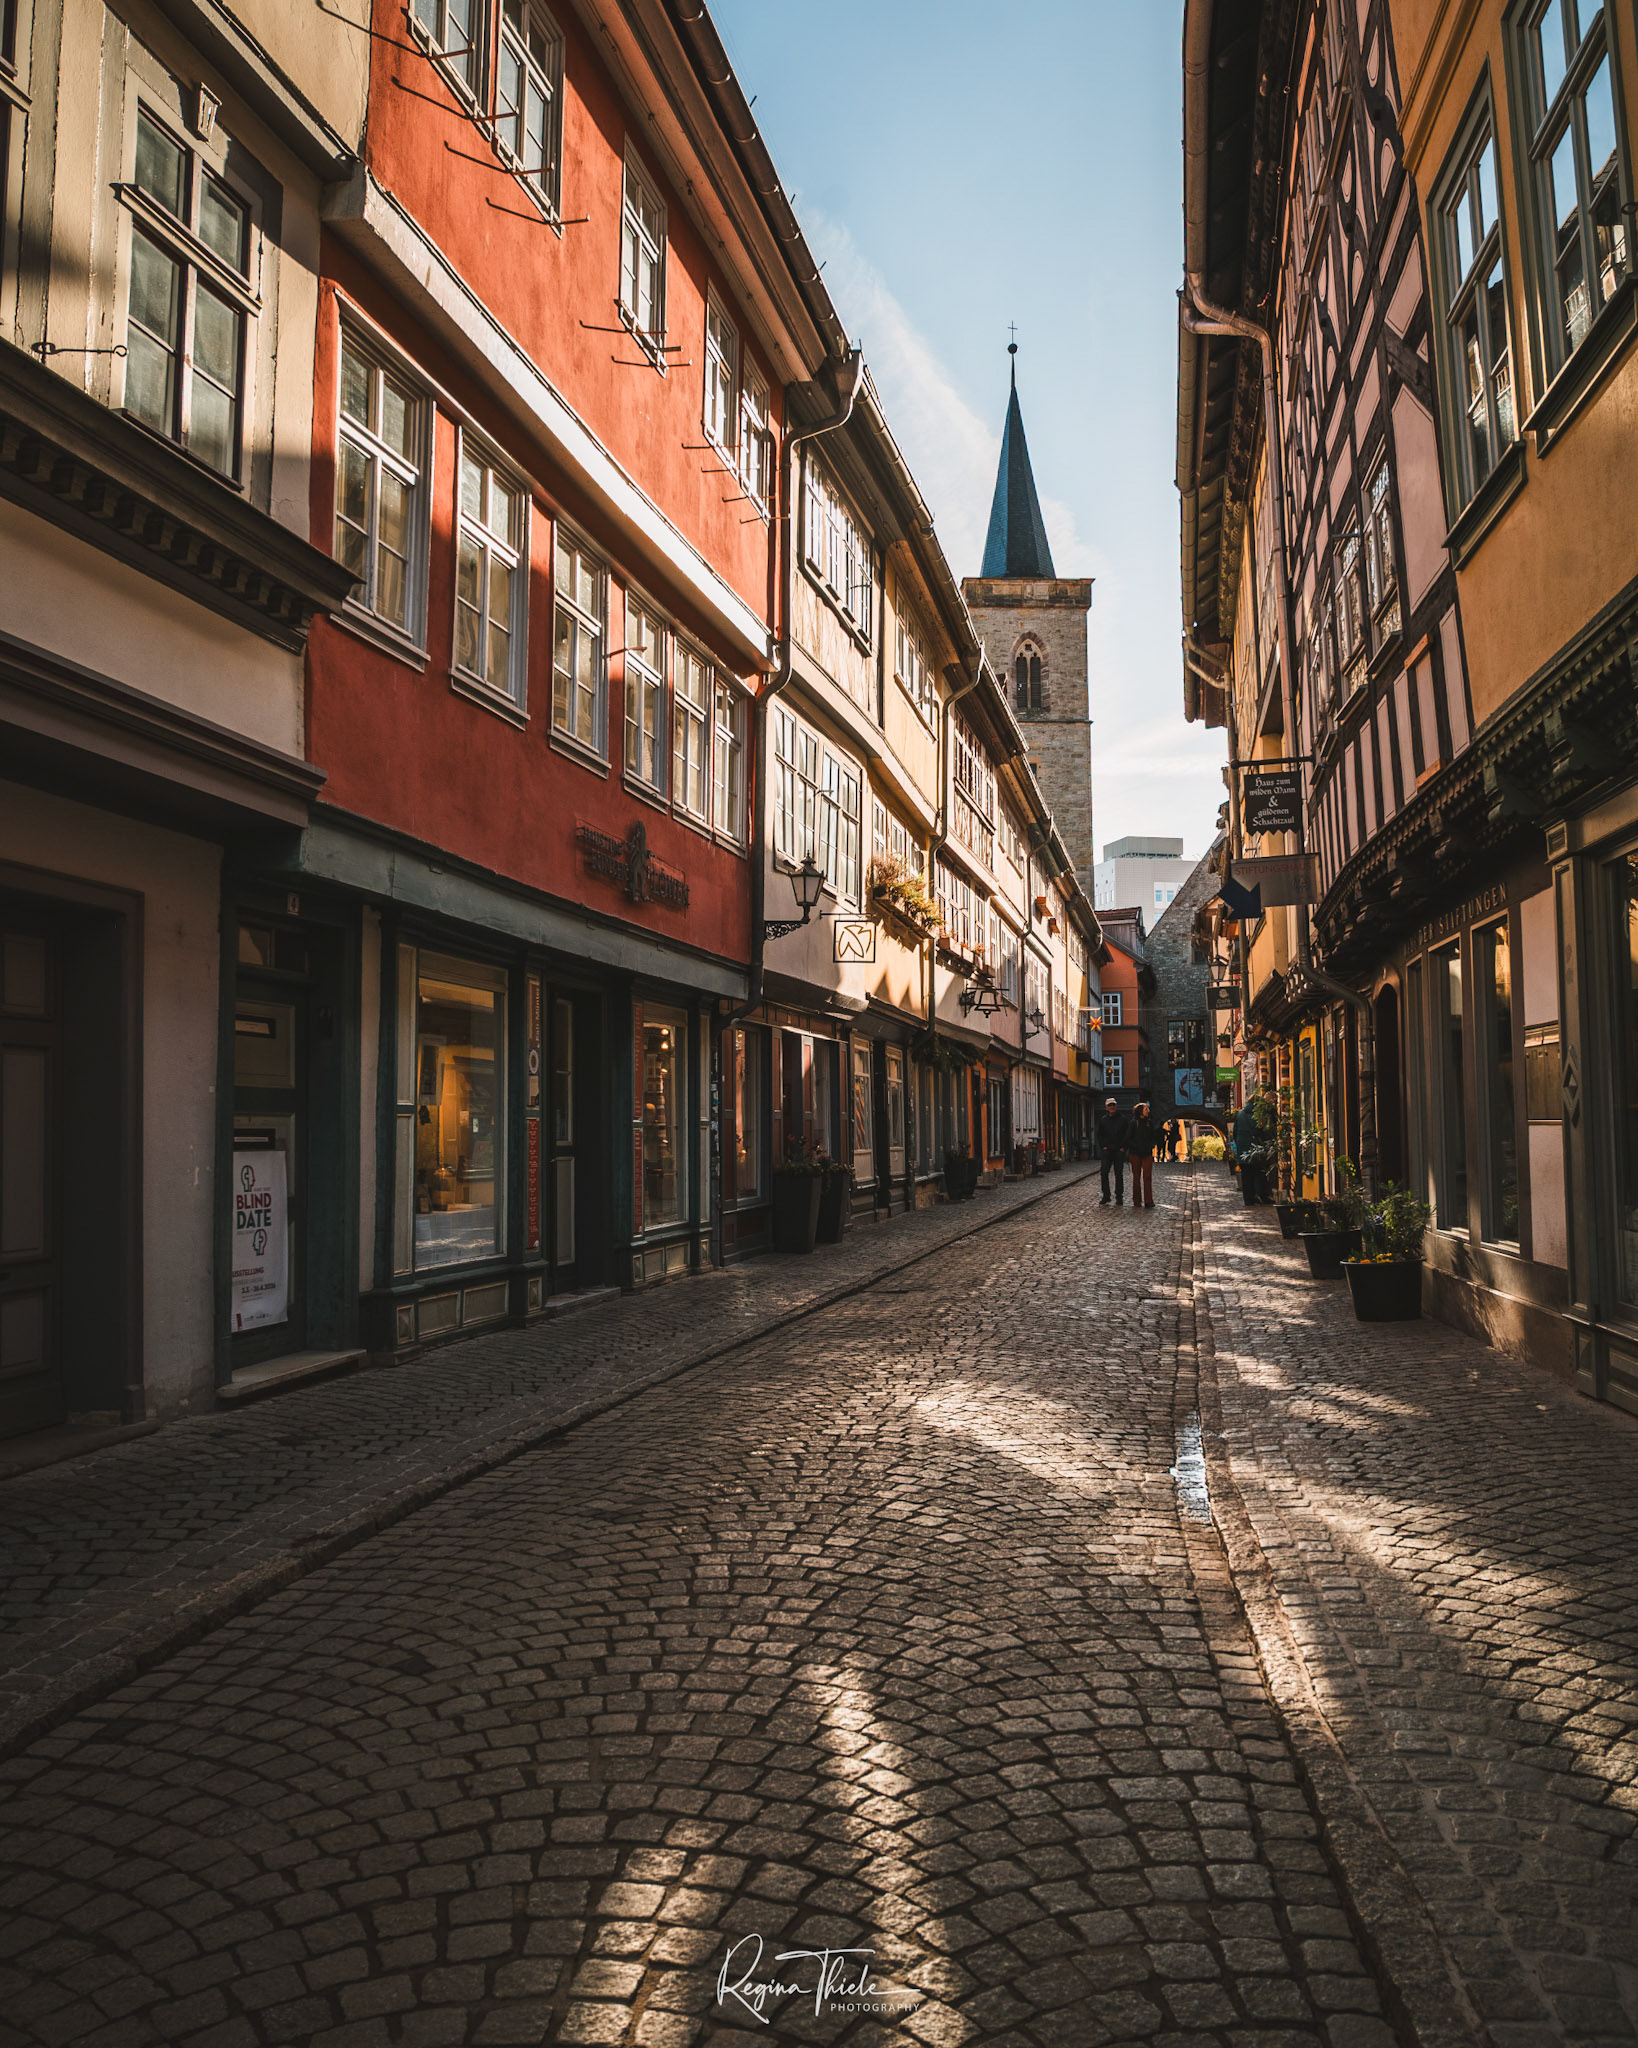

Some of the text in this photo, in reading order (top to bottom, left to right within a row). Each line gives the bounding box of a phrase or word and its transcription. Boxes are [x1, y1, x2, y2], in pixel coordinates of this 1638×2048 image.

[1255, 777, 1274, 788] Haus
[1249, 786, 1296, 796] wilden Mann
[1268, 795, 1278, 807] &
[1257, 808, 1289, 818] güldenen
[1439, 881, 1507, 935] STIFTUNGEN
[236, 1193, 272, 1210] BLIND
[237, 1208, 272, 1230] DATE
[232, 1266, 265, 1278] USSTELLUNG
